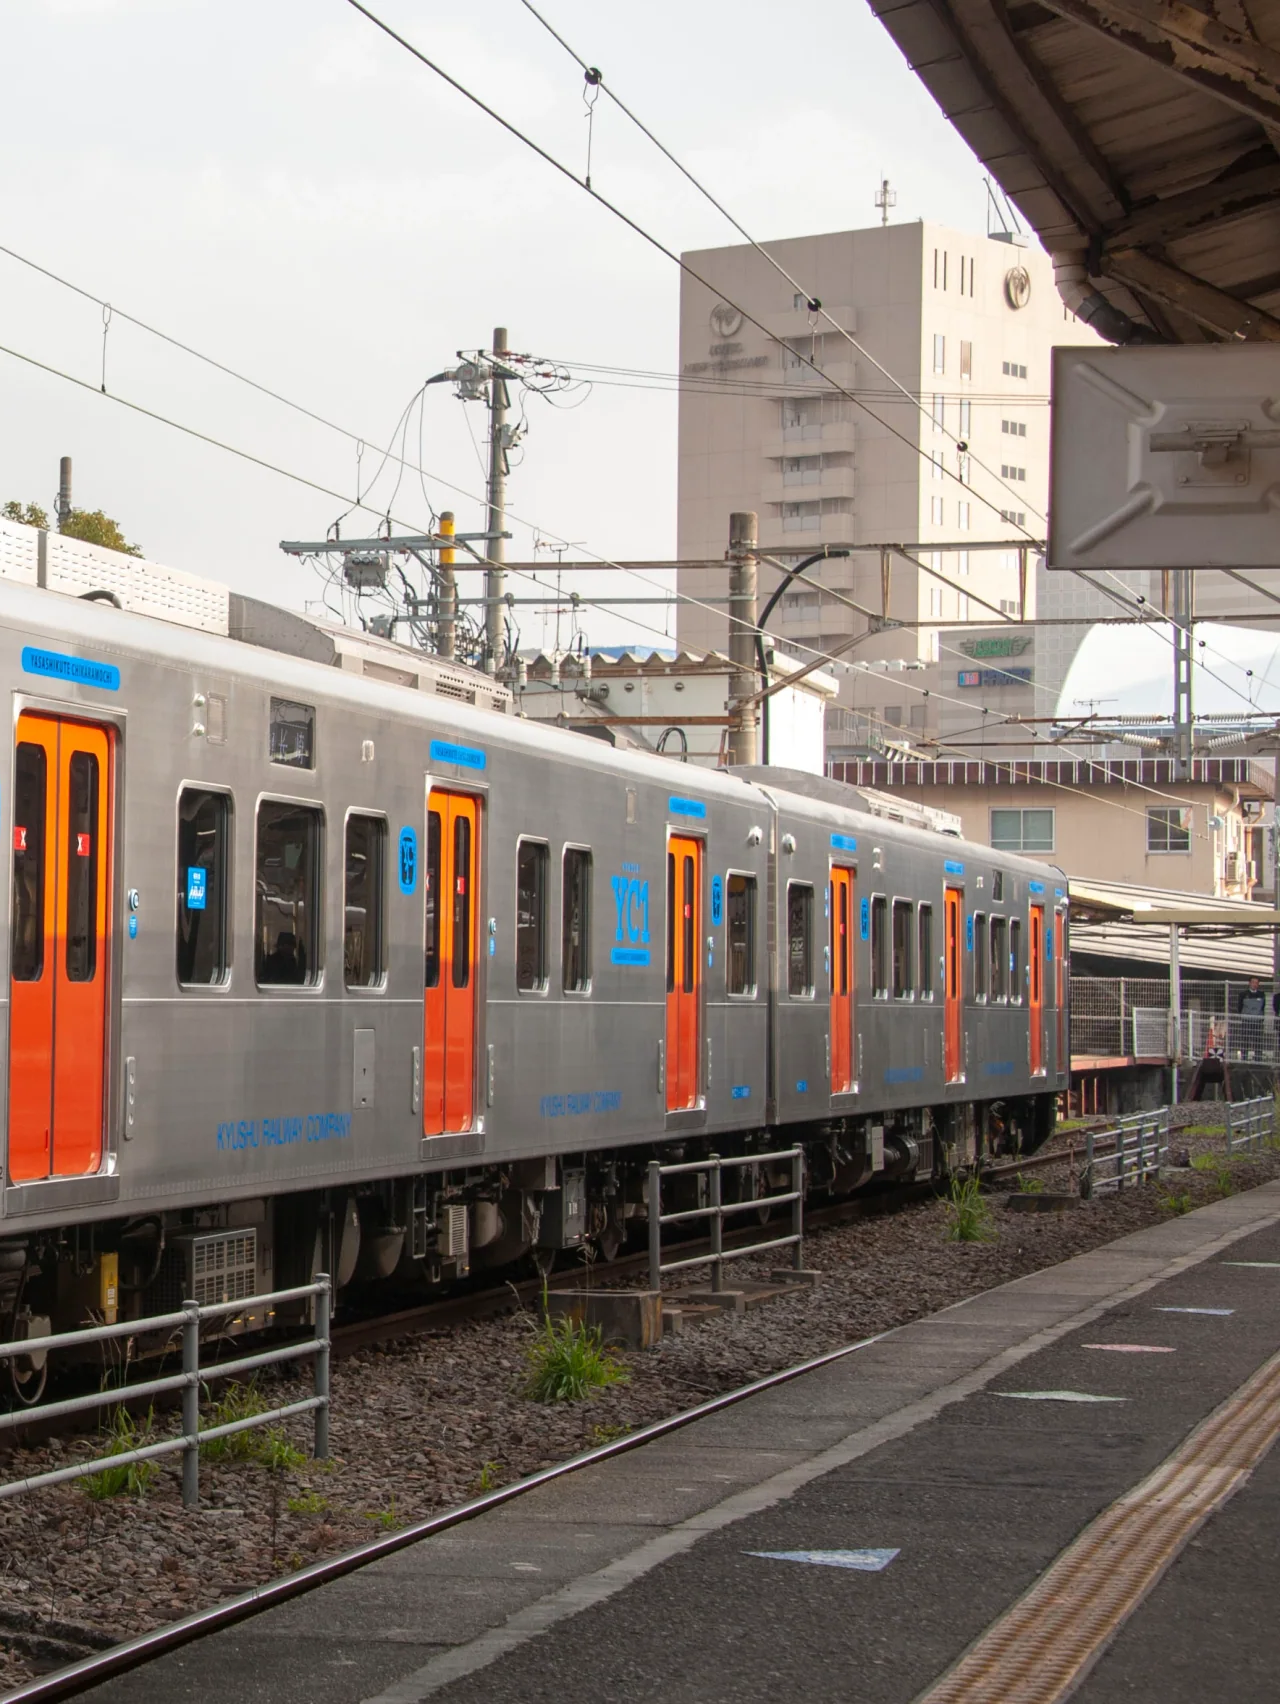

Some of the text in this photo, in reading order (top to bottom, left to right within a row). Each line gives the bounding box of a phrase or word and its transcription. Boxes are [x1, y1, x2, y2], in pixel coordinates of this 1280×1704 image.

[30, 653, 113, 685] YASASHIKUTE CHIKARAMOCHI
[611, 875, 651, 943] YC1
[217, 1112, 352, 1150] KYUSHU RAILWAY COMPANY
